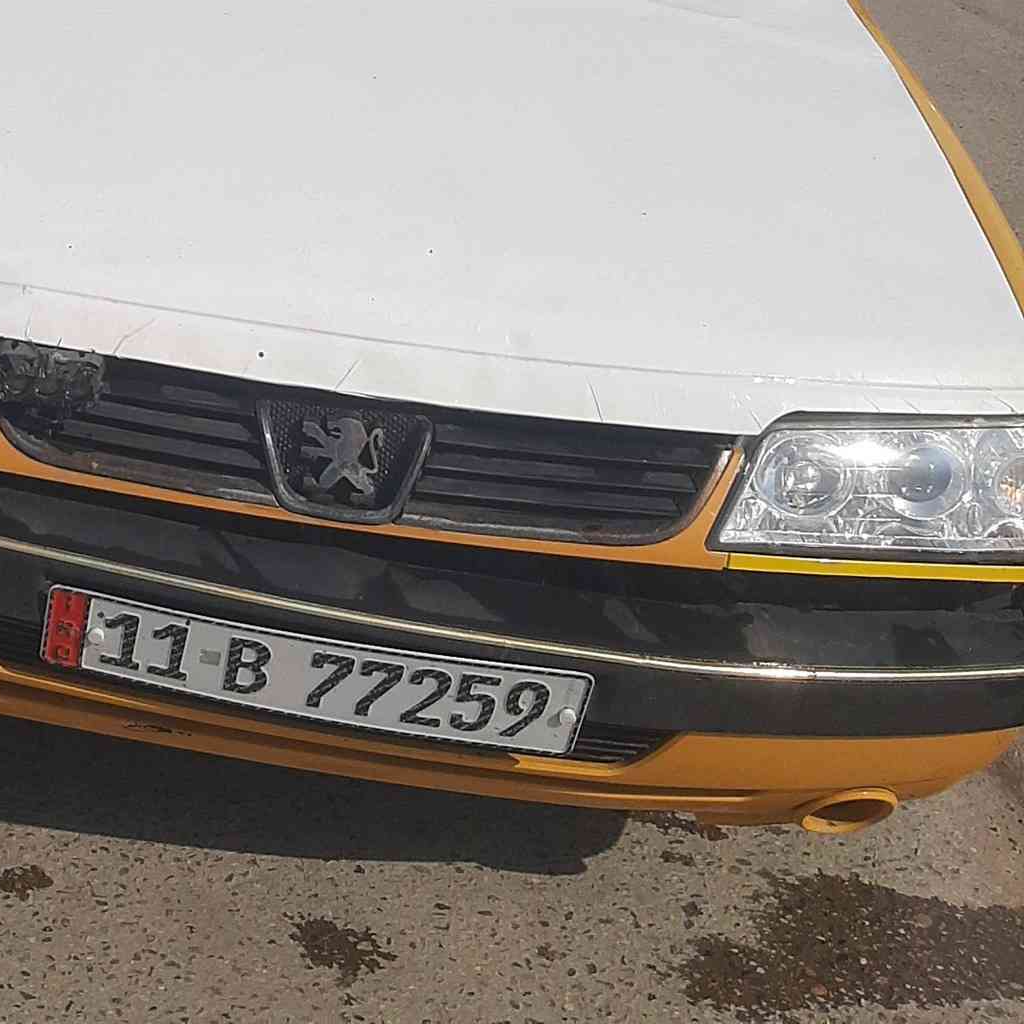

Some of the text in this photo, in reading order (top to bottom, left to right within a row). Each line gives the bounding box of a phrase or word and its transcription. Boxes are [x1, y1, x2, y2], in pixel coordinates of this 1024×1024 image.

[99, 612, 551, 738] 11 B 77259
